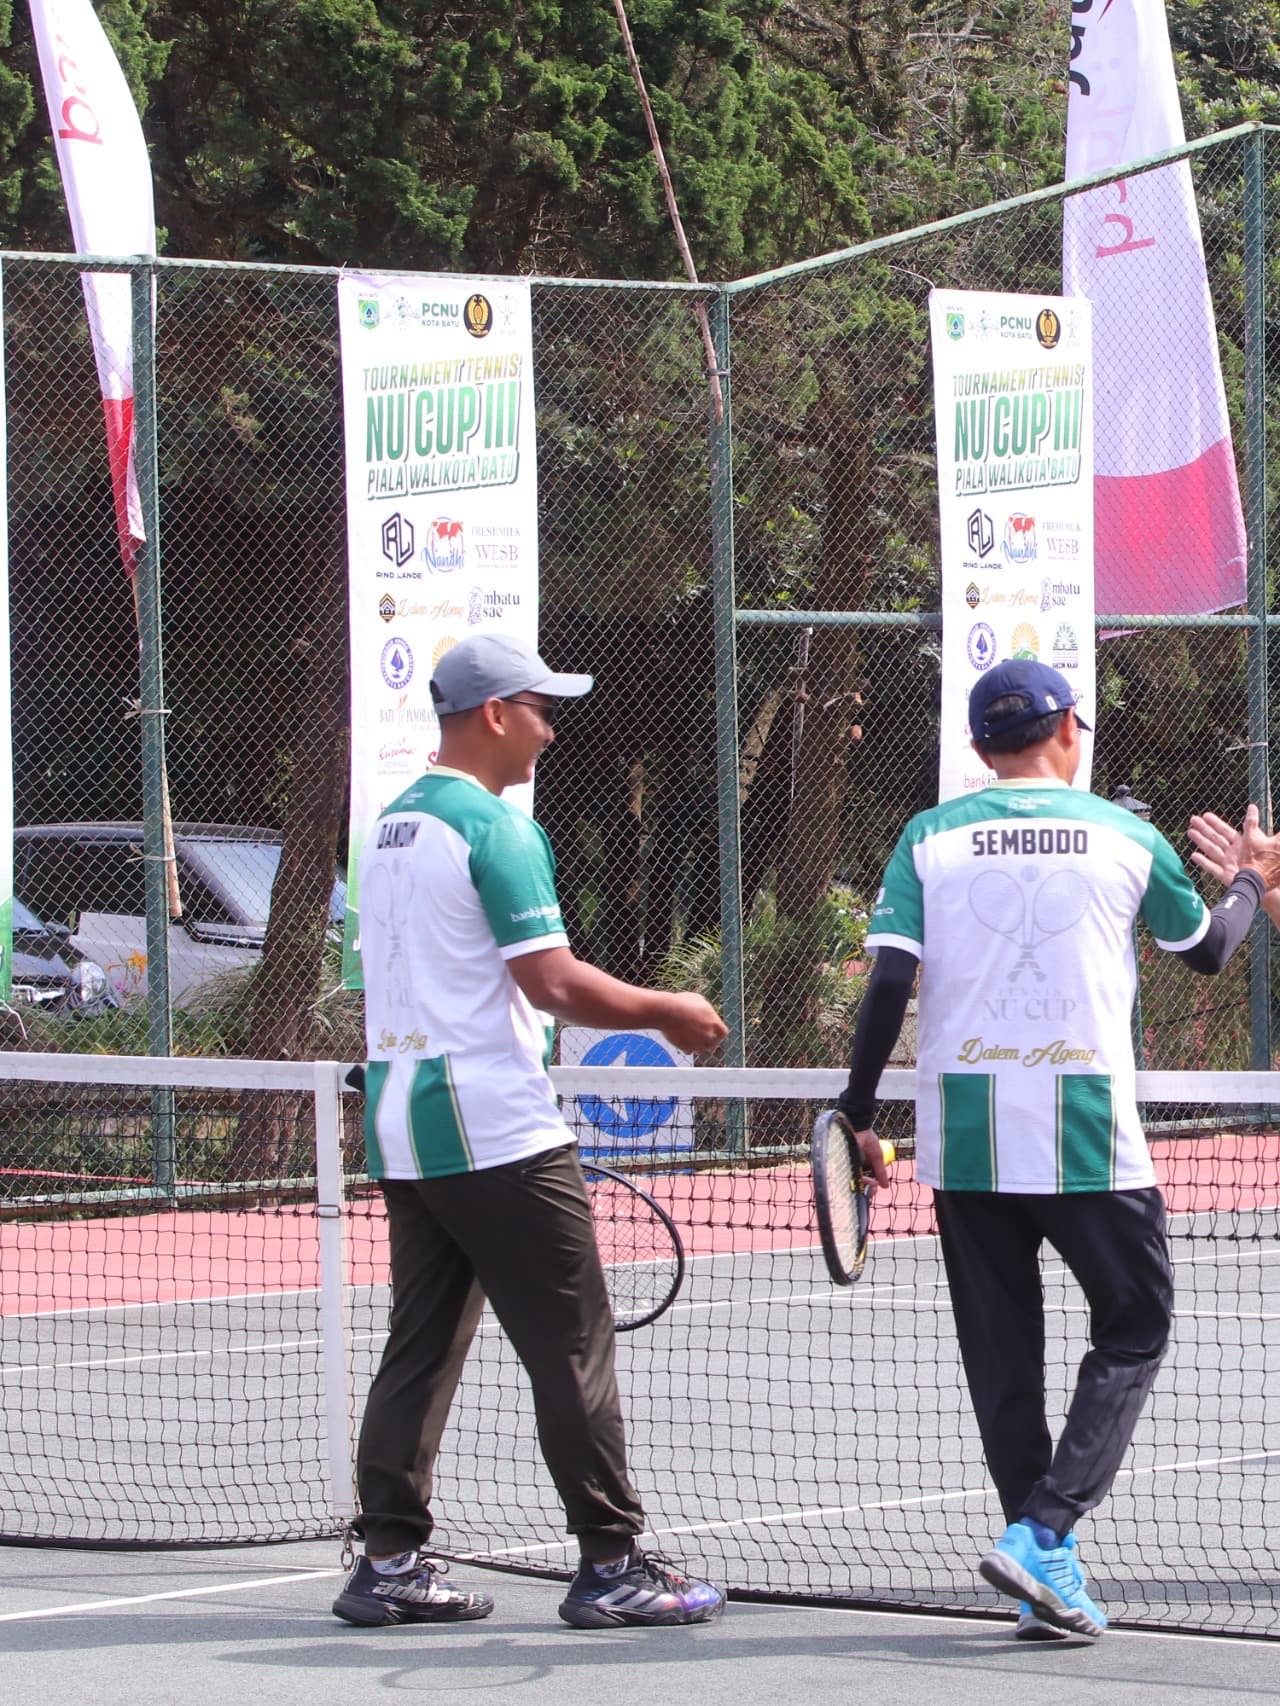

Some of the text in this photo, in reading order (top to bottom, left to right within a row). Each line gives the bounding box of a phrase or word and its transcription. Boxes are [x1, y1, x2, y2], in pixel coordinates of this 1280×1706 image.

[422, 302, 460, 317] PCNU
[422, 320, 460, 328] KOTA BATU
[1000, 316, 1032, 330] PCNU
[363, 353, 520, 392] TOURNAMENT TENNIS
[953, 363, 1082, 397] TOURNAMENT TENNIS
[366, 381, 517, 463] NU CUP III
[954, 389, 1080, 462] NU CUP III
[368, 453, 516, 494] PIALA WALIKOTA BATU
[955, 455, 1079, 491] PIALA WALIKOTA BATU
[474, 544, 519, 561] WESB
[1046, 537, 1079, 554] WESB
[376, 571, 423, 579] RINO LANDE
[484, 589, 520, 606] mbatu
[1051, 596, 1067, 607] sae
[482, 605, 504, 618] sae
[972, 828, 1088, 856] SEMBODO
[983, 998, 1077, 1021] NU CUP
[957, 1036, 1096, 1068] Dalem Ageng
